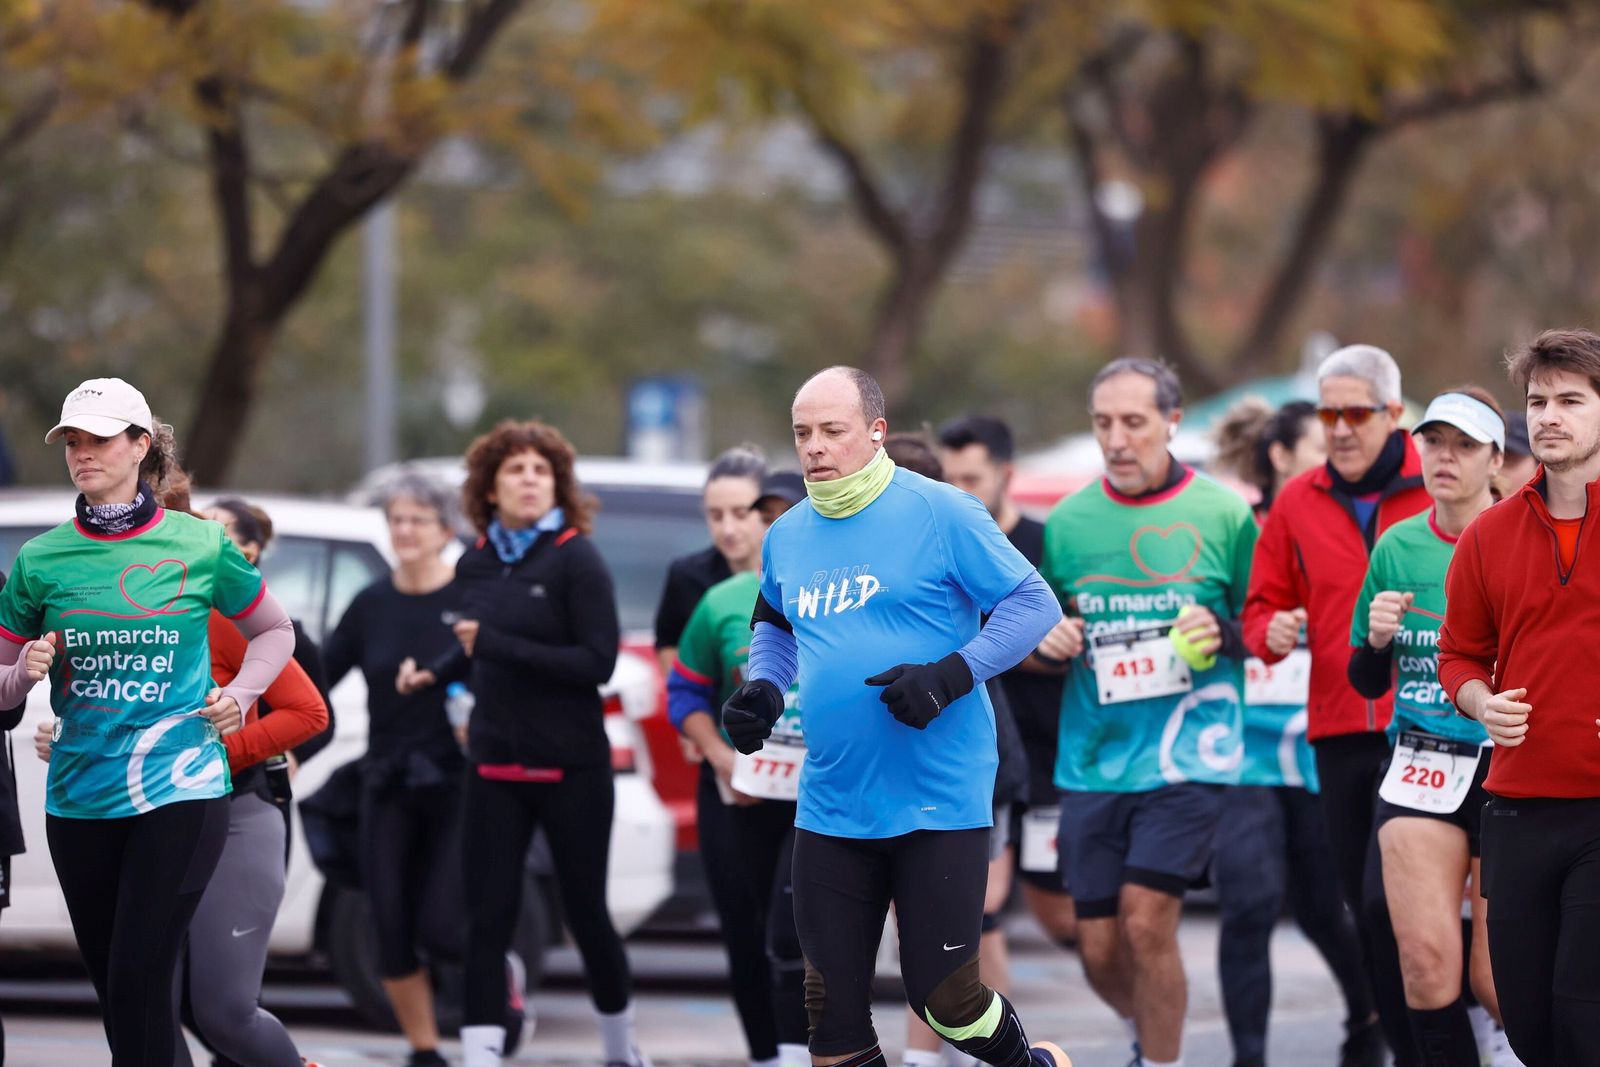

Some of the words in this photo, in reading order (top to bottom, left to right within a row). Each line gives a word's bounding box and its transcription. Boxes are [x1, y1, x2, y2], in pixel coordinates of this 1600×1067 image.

[806, 564, 870, 594] RUN
[797, 575, 880, 618] WILD
[1077, 592, 1105, 614] En
[65, 628, 90, 648] En
[96, 625, 179, 645] marcha
[71, 650, 147, 671] contra
[151, 650, 174, 673] el
[1113, 657, 1155, 678] 413
[71, 672, 171, 703] cáncer
[752, 758, 796, 777] 777
[1402, 765, 1445, 788] 220
